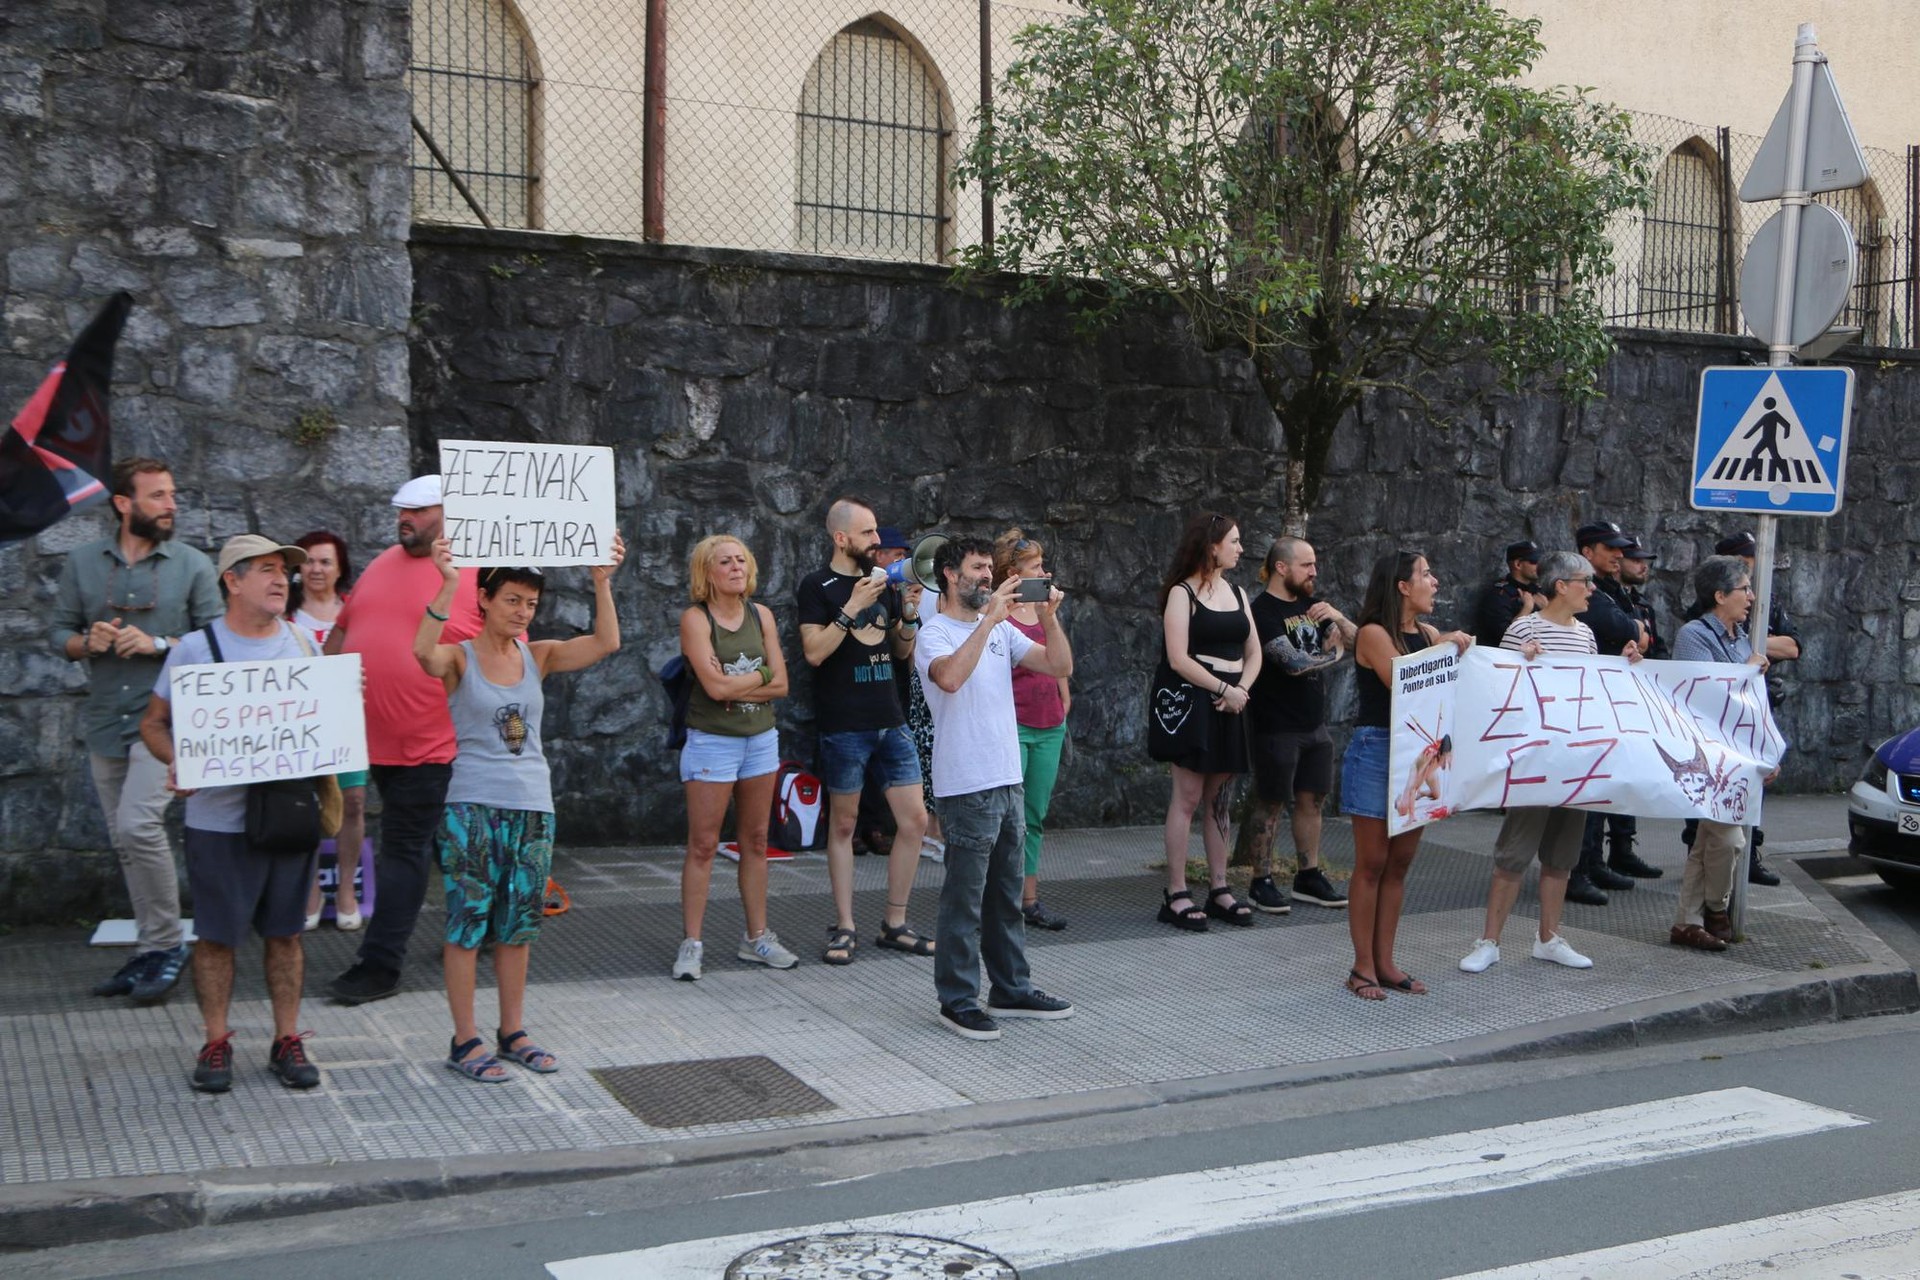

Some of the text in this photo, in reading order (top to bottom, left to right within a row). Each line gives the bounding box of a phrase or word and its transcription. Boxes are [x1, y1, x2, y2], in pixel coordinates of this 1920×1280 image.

[443, 447, 596, 502] ZEZENAK
[173, 664, 311, 696] FESTAK
[854, 663, 892, 682] NOT ALON
[1400, 654, 1453, 681] Dibertigarria
[1402, 669, 1458, 694] Ponte en su lug
[191, 699, 319, 730] OSPATU
[1479, 662, 1781, 761] ZEZENKETAK
